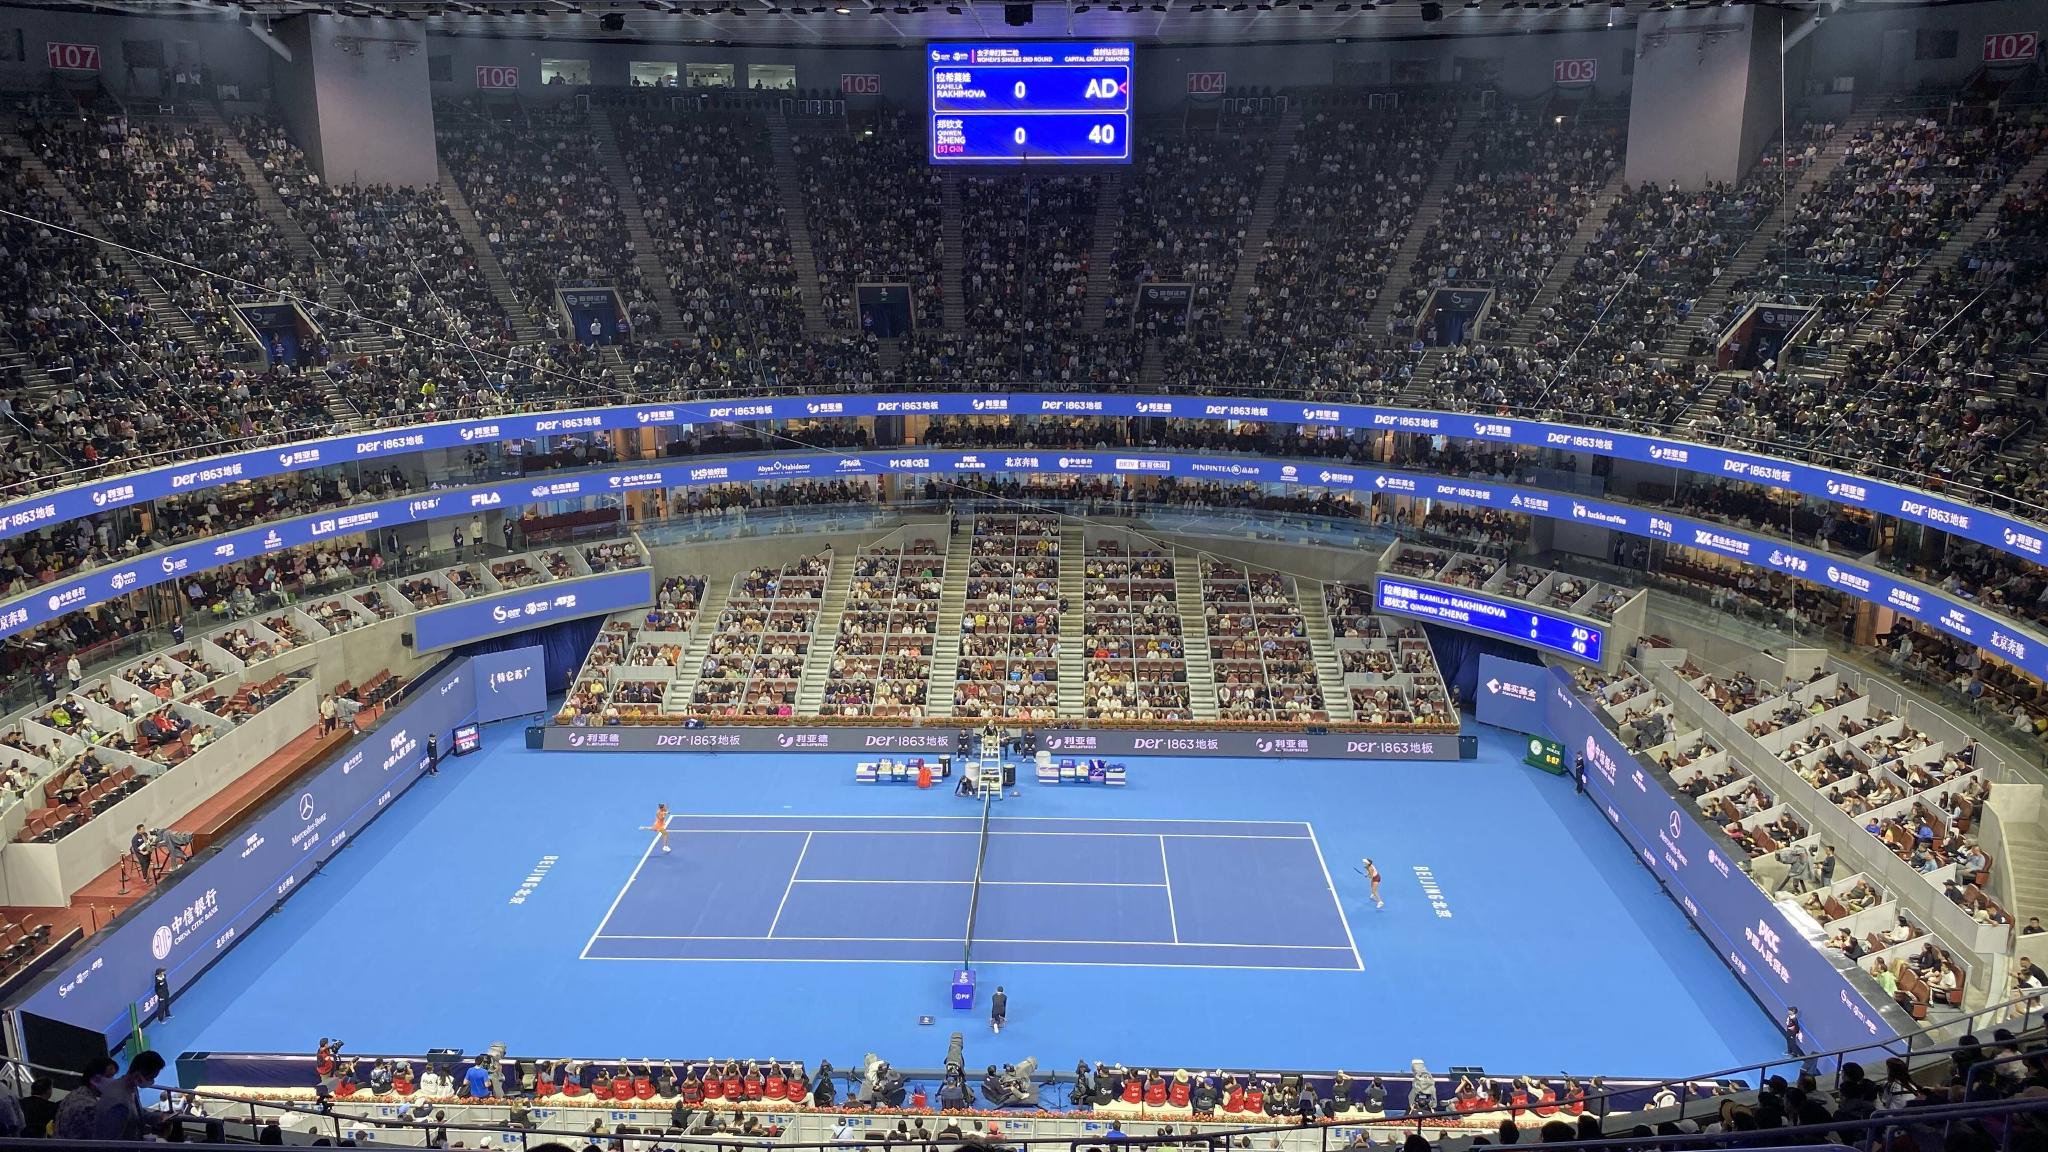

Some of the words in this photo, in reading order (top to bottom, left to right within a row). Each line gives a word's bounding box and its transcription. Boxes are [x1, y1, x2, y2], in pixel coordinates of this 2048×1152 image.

[1987, 35, 2034, 58] 102
[51, 45, 96, 68] 107
[479, 67, 517, 86] 106
[1556, 61, 1594, 79] 103
[844, 77, 877, 92] 105
[1015, 81, 1026, 98] 0
[1085, 79, 1118, 98] AD
[1190, 74, 1223, 91] 104
[937, 90, 986, 98] RAKHIMOVA
[937, 120, 963, 129] 郑钦文
[938, 136, 966, 145] ZHENG
[1015, 127, 1026, 144] 0
[1089, 124, 1115, 143] 40
[1005, 457, 1039, 468] 北京奔驰
[1192, 464, 1231, 472] PINPINTEA
[471, 492, 501, 506] FILA
[1588, 511, 1606, 521] luckin
[1607, 515, 1627, 525] coffee
[1419, 593, 1449, 606] KAMILLA
[1451, 597, 1506, 619] RAKHIMOVA
[1531, 616, 1538, 626] 0
[1572, 628, 1588, 641] AD
[1410, 603, 1437, 615] QINWEN
[1439, 608, 1469, 622] ZHENG
[1530, 629, 1537, 638] 0
[1572, 641, 1586, 654] 40
[1991, 630, 2025, 660] 北京奔驰
[1503, 683, 1536, 698] 嘉实基金
[391, 729, 407, 751] PICC
[587, 733, 619, 743] 利亚德
[796, 734, 828, 743] 利亚德
[1064, 737, 1096, 745] 利亚德
[1275, 739, 1308, 748] 利亚德
[292, 813, 327, 847] Mercedes-Benz
[172, 888, 217, 935] 中信银行
[174, 929, 191, 946] CHINA
[191, 919, 205, 932] CITIC
[204, 907, 219, 921] BANK
[1758, 919, 1780, 954] PICC
[1745, 926, 1791, 984] 中国人民保险
